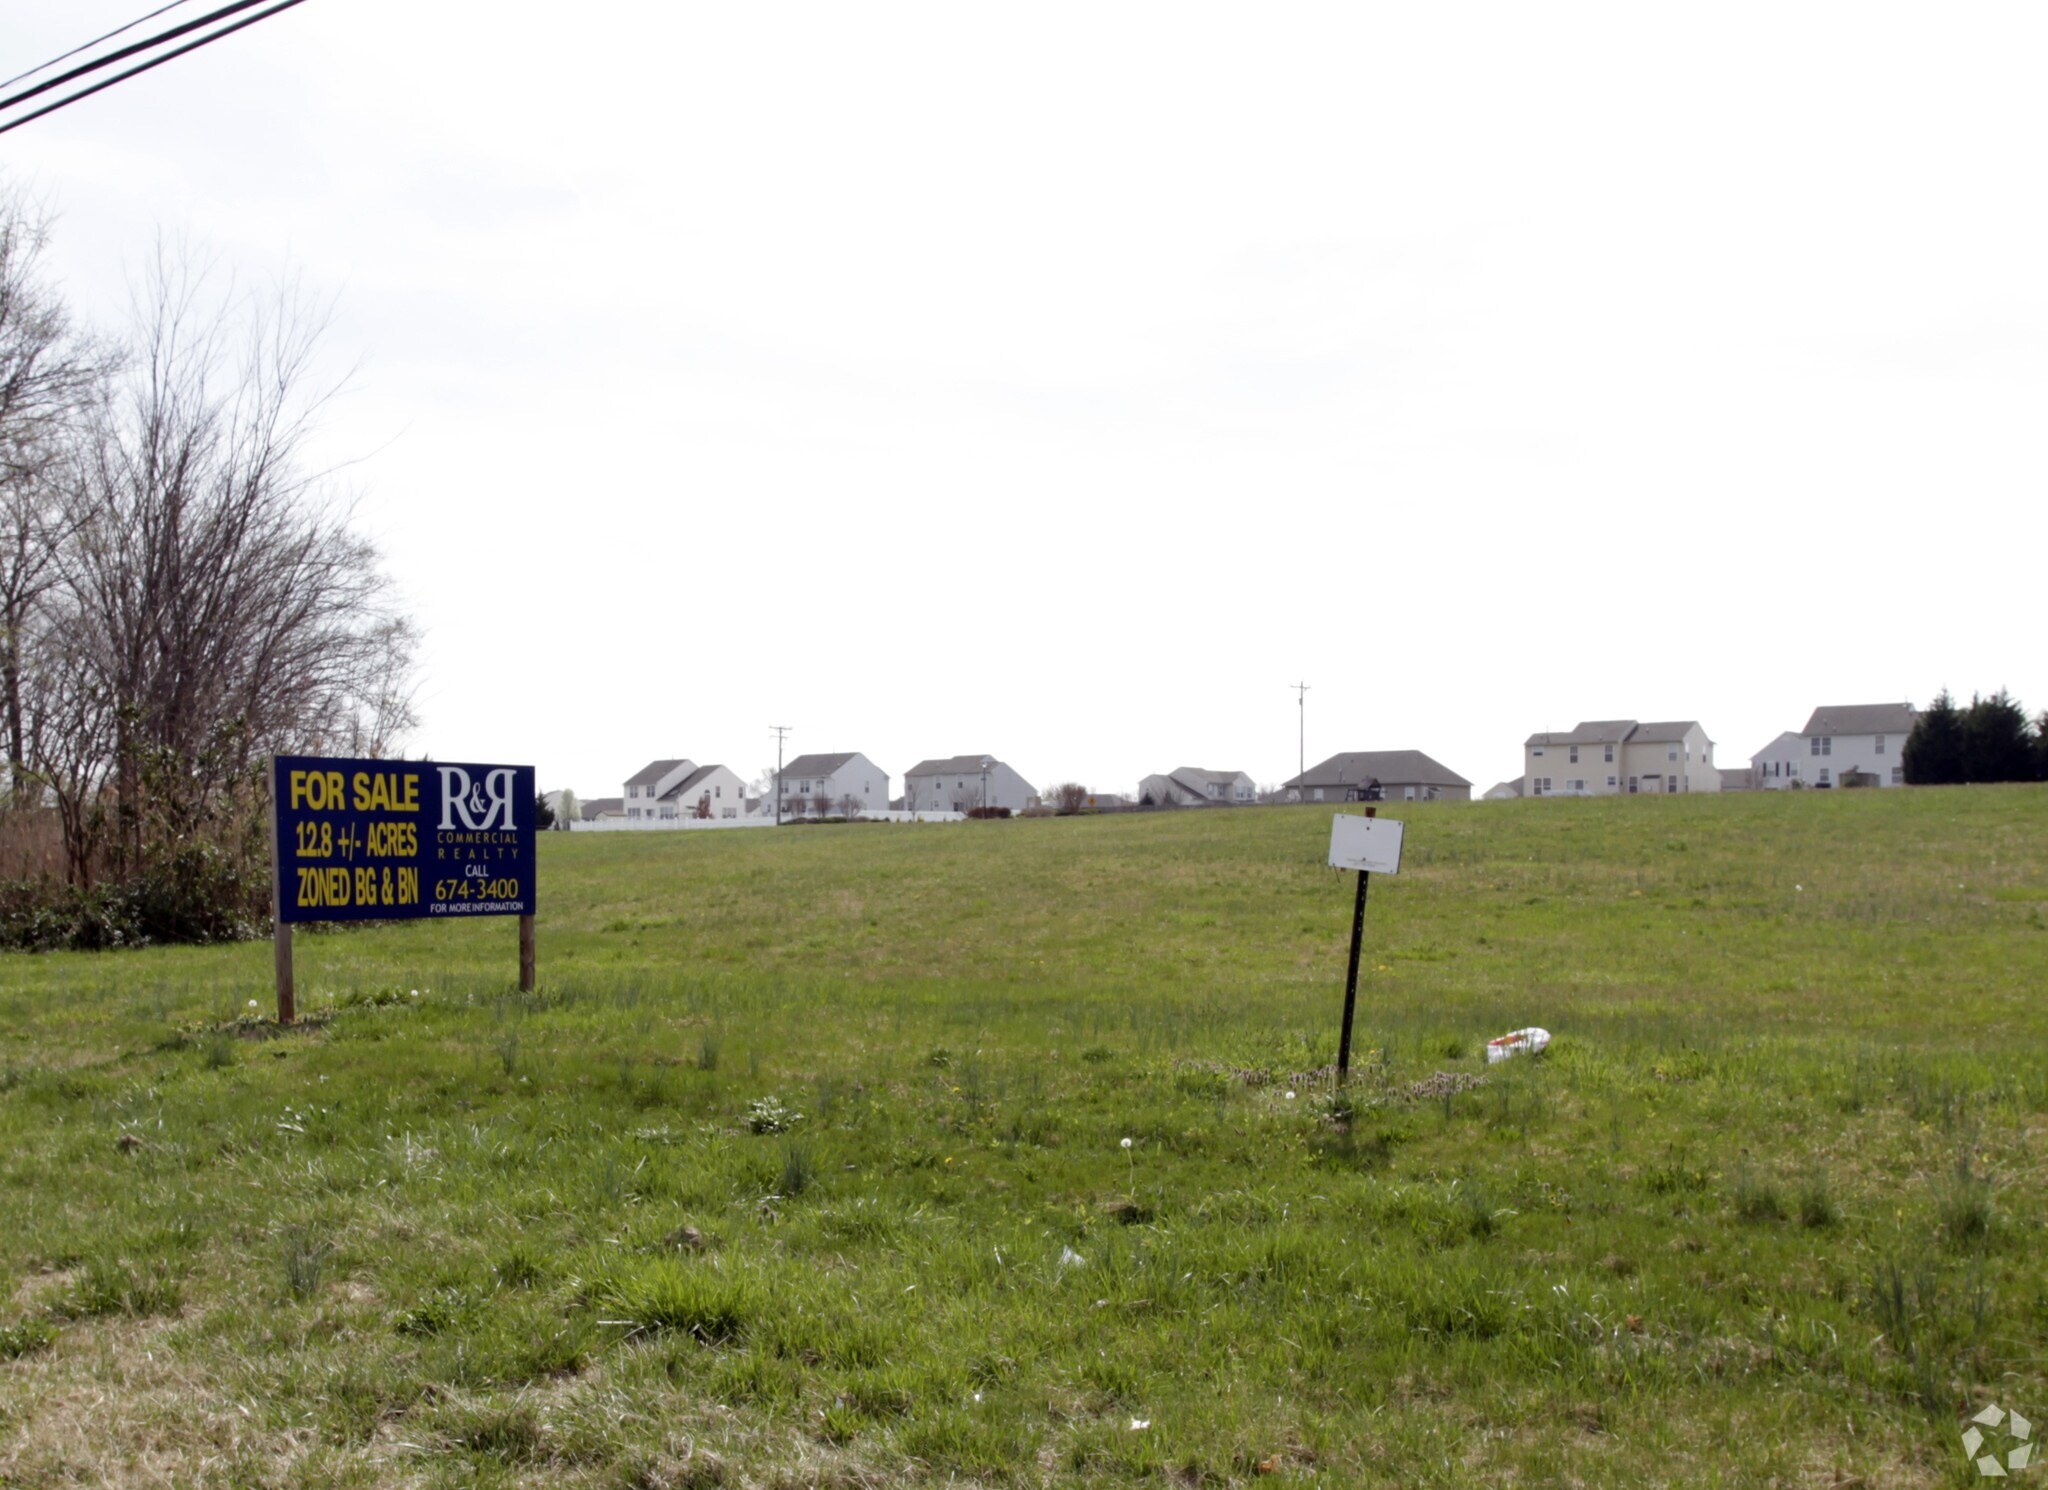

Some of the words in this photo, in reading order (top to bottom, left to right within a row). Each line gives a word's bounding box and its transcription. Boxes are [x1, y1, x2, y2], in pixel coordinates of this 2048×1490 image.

[290, 770, 346, 810] FOR
[352, 772, 419, 811] SALE
[296, 821, 332, 858] 12.8
[337, 822, 361, 861] +/-
[366, 822, 417, 857] ACRES
[437, 832, 518, 844] COMMERCIAL
[438, 848, 519, 860] REALTY
[465, 865, 489, 877] CALL
[297, 867, 350, 907] ZONED
[355, 866, 377, 905] BG
[381, 866, 394, 905] &
[398, 867, 418, 904] BN
[435, 879, 519, 900] 674-3400
[430, 904, 447, 913] FOR
[449, 903, 471, 912] MORE
[472, 902, 524, 912] INFORMATION
